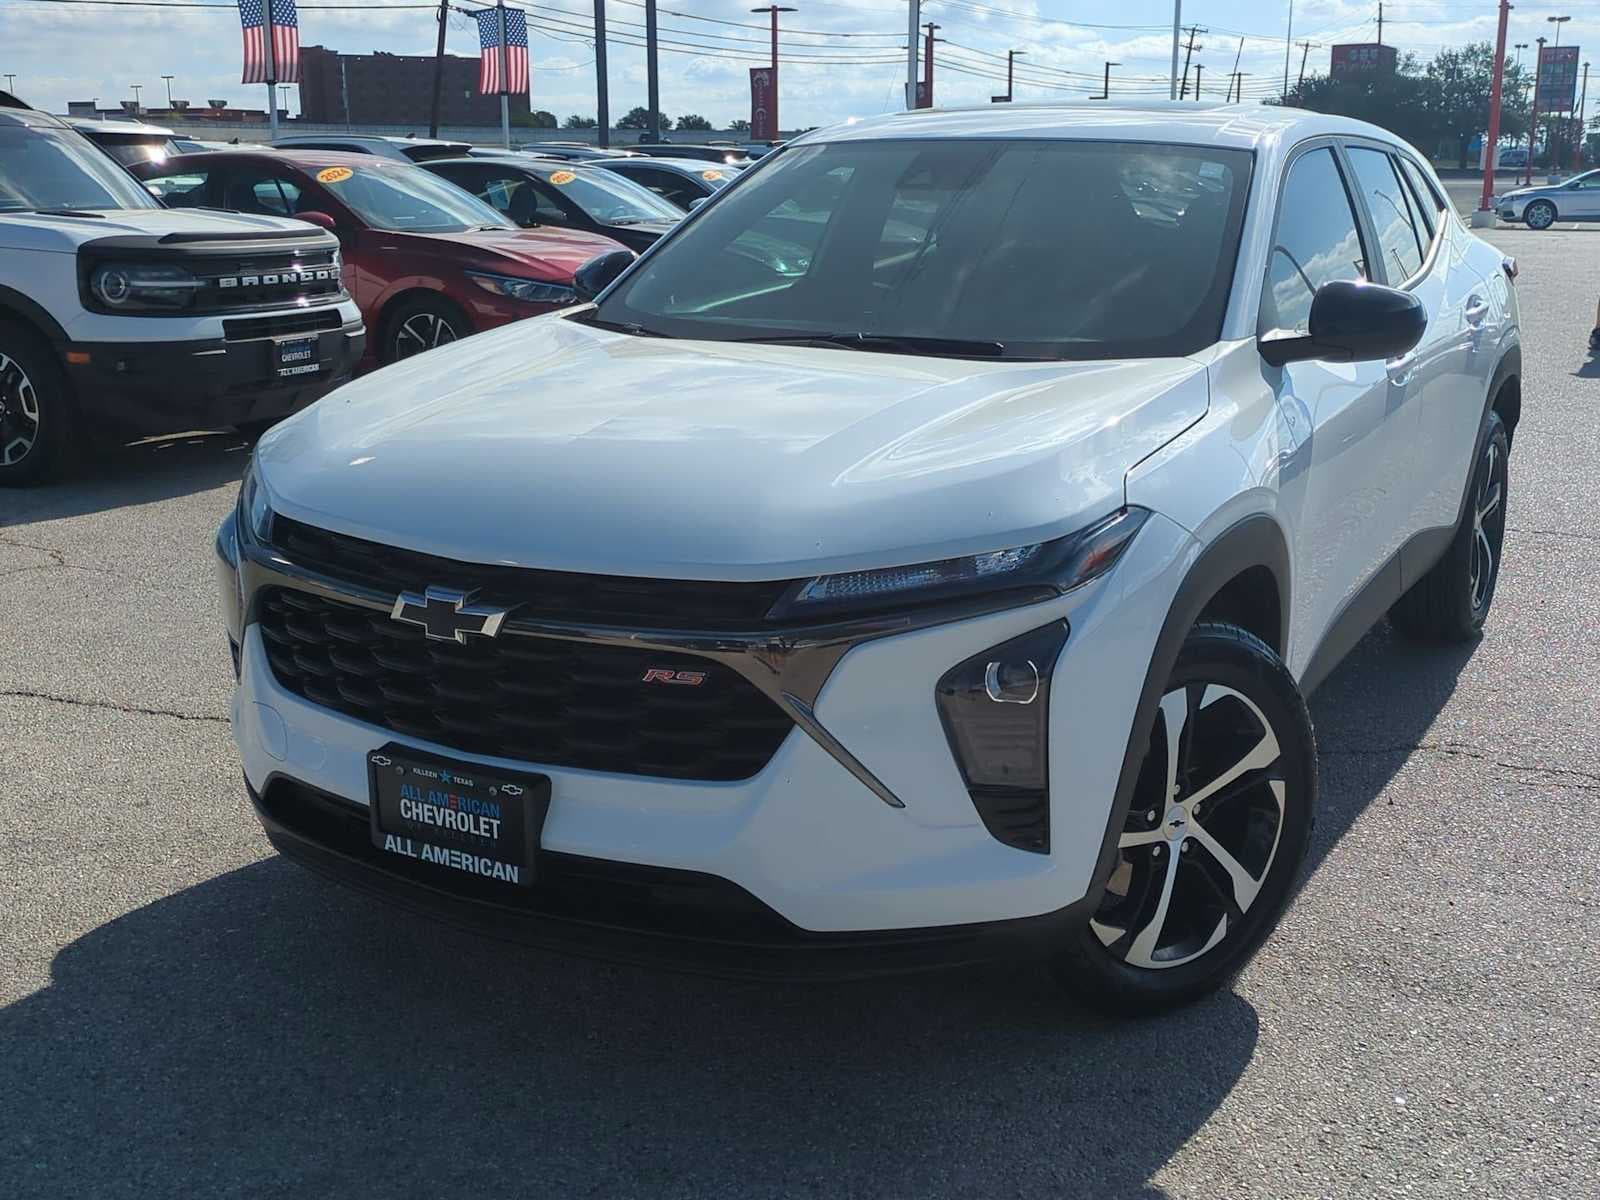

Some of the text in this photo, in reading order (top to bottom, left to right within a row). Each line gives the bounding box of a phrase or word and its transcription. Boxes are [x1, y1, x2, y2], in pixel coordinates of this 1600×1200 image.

[219, 270, 329, 288] BRONCO
[642, 669, 706, 686] RS
[412, 767, 474, 787] KILLEEN TEXAS
[401, 783, 500, 817] ALL AMERICAN
[400, 799, 500, 839] CHEVROLET
[384, 834, 418, 858] ALL
[421, 844, 519, 884] AMERICAN
